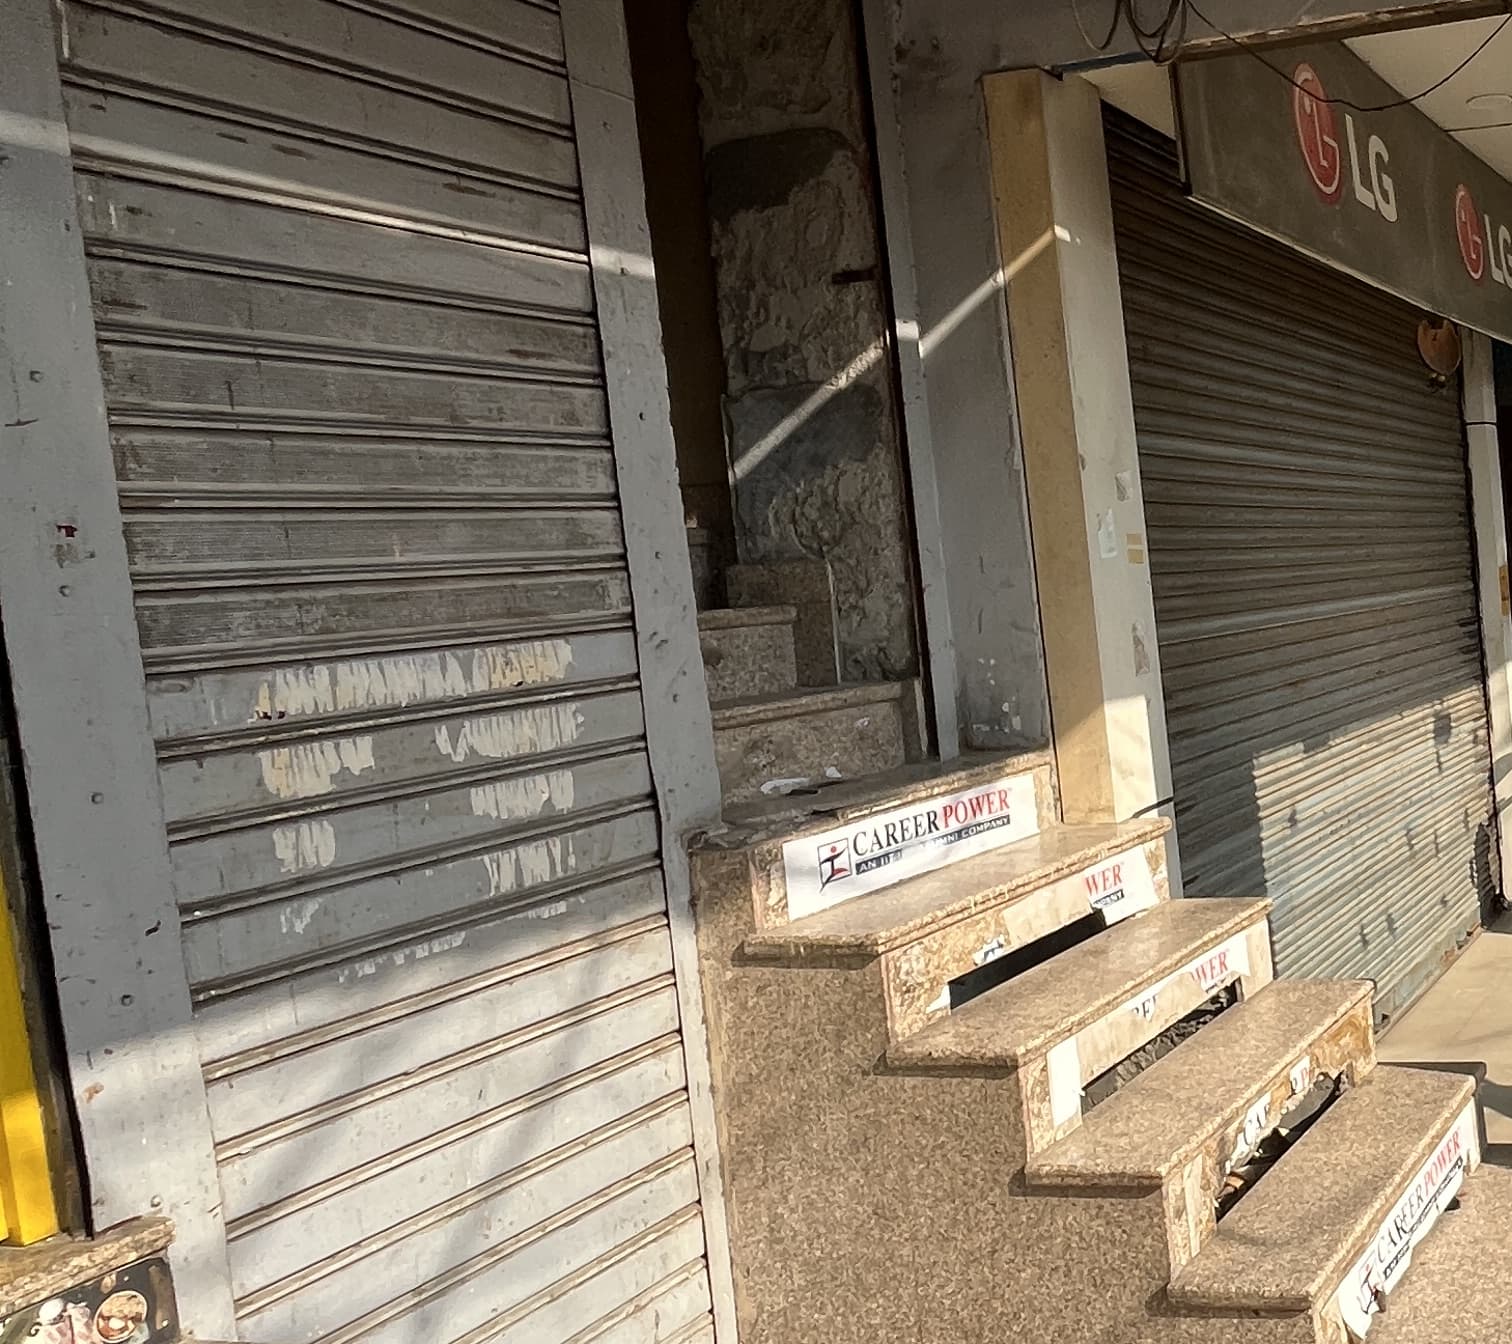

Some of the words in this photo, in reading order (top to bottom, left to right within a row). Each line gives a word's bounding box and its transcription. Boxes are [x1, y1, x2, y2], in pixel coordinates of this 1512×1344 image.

[1344, 113, 1398, 223] LG
[853, 810, 940, 856] CAREER
[942, 789, 1011, 829] POWER
[859, 858, 877, 873] AN
[961, 817, 1010, 838] COMPANY
[1377, 1184, 1424, 1264] CAREER
[1424, 1131, 1461, 1197] POWER
